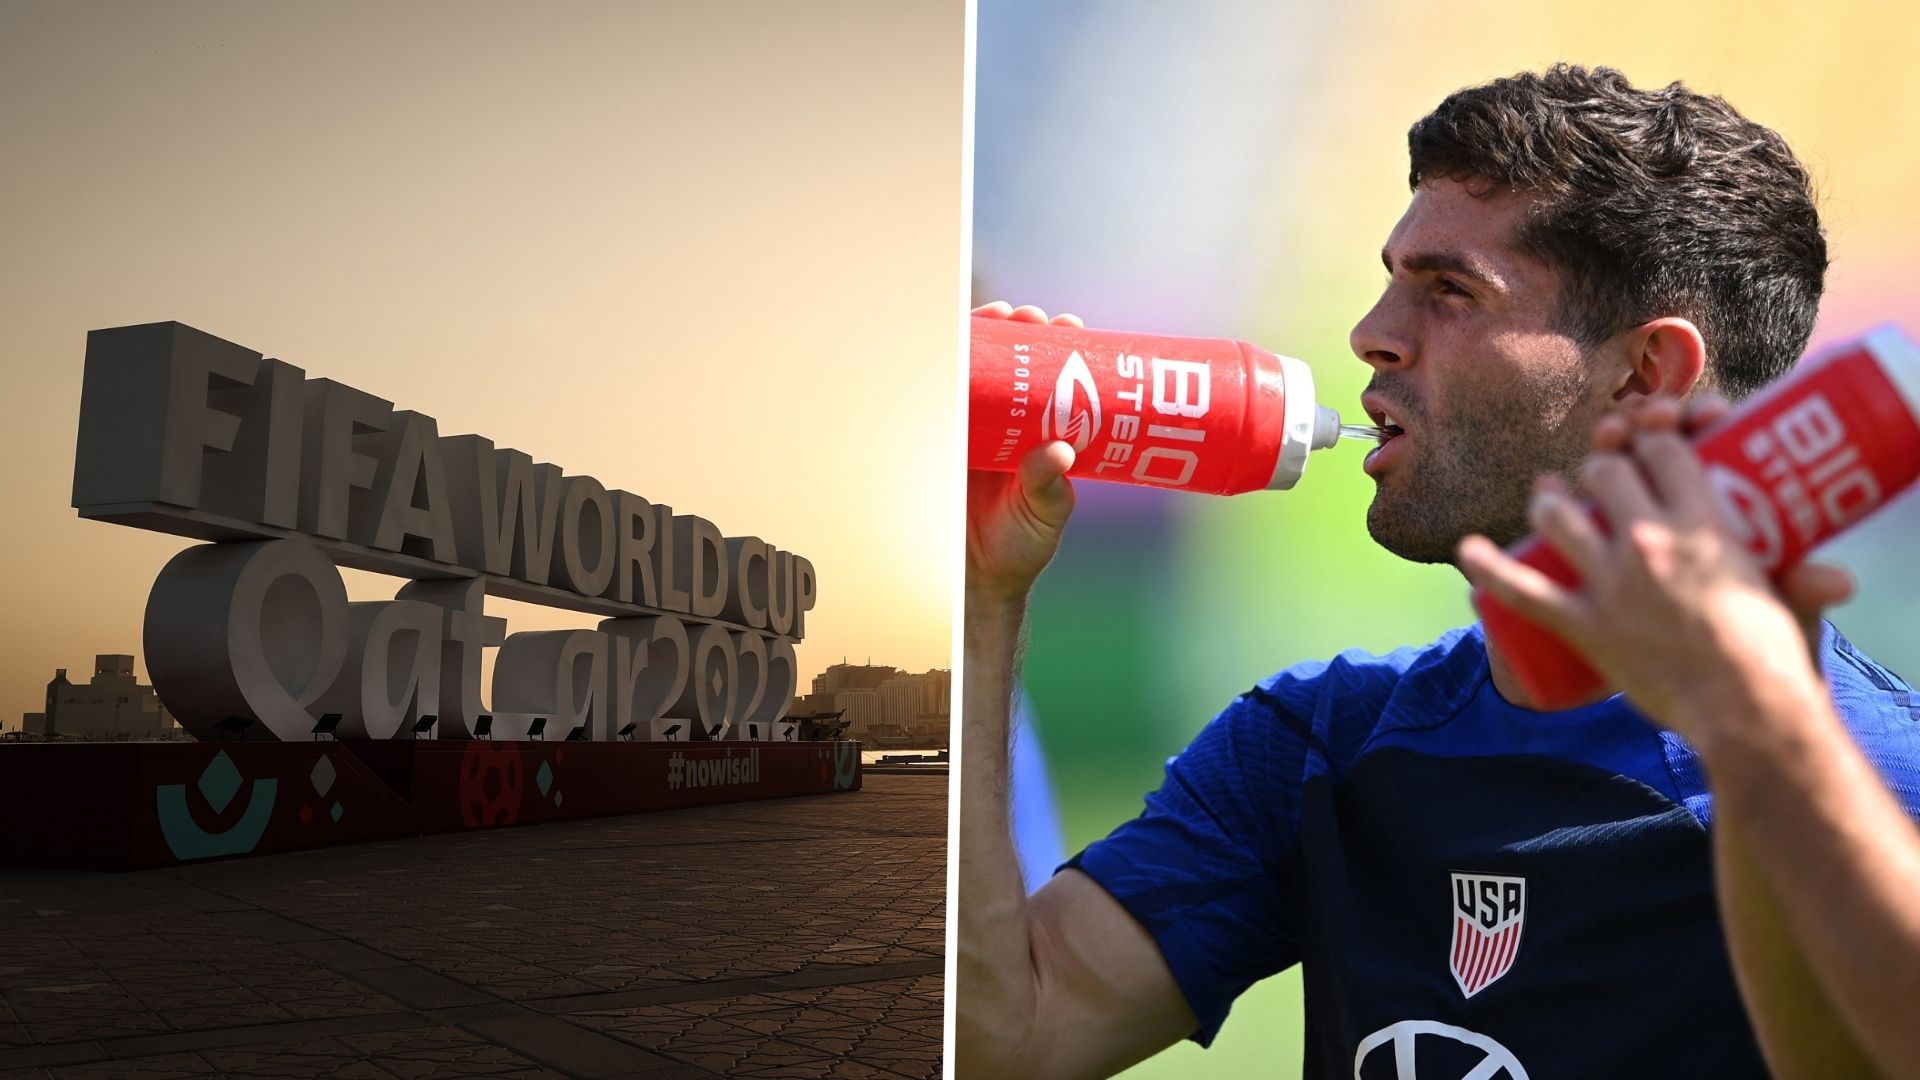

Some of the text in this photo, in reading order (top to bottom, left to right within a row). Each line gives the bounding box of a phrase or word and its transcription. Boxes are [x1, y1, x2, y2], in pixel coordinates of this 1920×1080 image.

[1010, 343, 1030, 418] SPORTS
[1095, 352, 1144, 474] STEEL
[1131, 357, 1212, 486] BIO
[158, 320, 817, 640] FIFA WORLD CUP
[1772, 391, 1882, 527] BIO
[667, 747, 760, 790] #nowisall
[1455, 878, 1522, 930] USA
